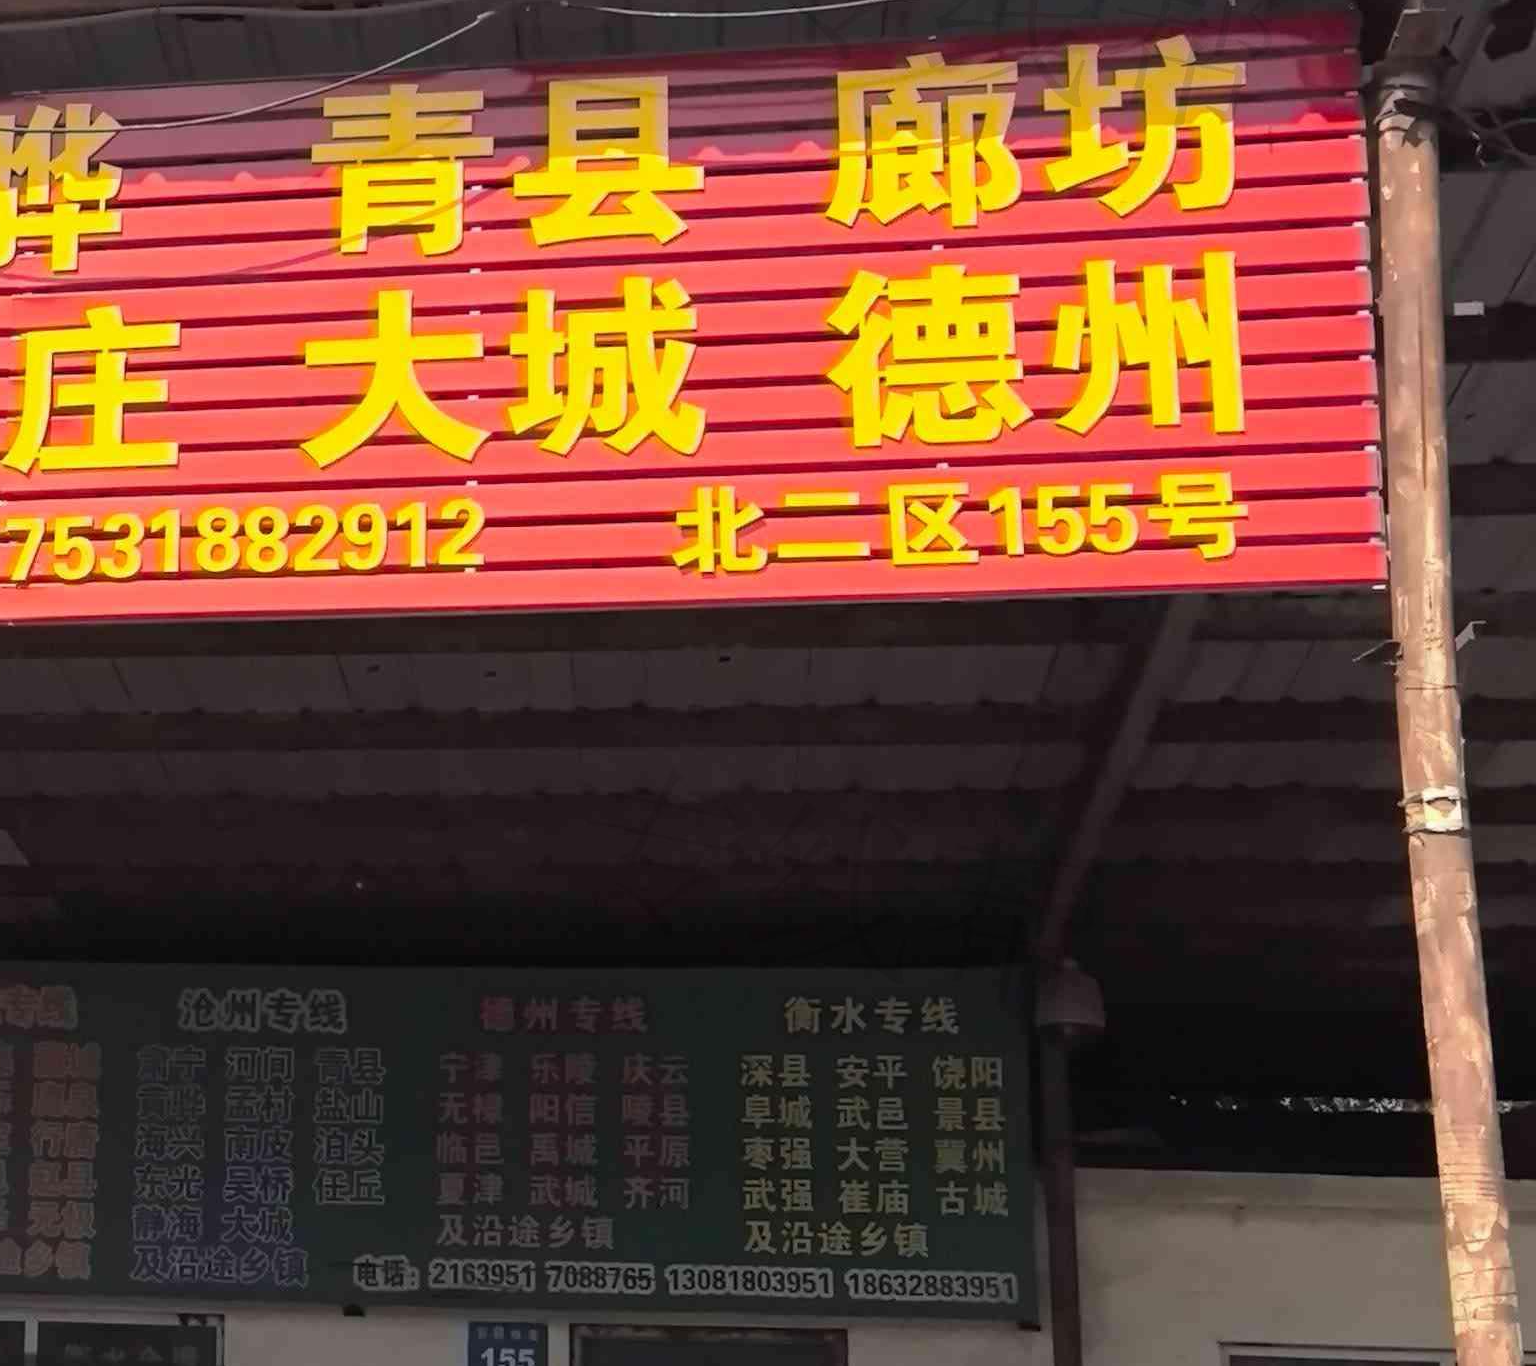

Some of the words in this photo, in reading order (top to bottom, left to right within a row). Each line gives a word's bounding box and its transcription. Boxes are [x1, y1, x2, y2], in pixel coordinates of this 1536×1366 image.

[311, 76, 704, 256] 青县
[821, 36, 1247, 228] 廊坊
[298, 274, 706, 469] 大城
[824, 250, 1245, 449] 德州
[670, 471, 1249, 574] 北二区155号
[178, 987, 347, 1033] 沧州专线
[479, 994, 648, 1034] 德州专线
[784, 996, 961, 1035] 衡水专线
[225, 1045, 295, 1083] 河间
[313, 1047, 387, 1085] 青县
[623, 1053, 689, 1085] 庆云
[741, 1055, 812, 1089] 深县
[836, 1055, 909, 1089] 安平
[931, 1056, 1005, 1090] 饶阳
[224, 1084, 296, 1123] 孟村
[313, 1086, 384, 1124] 盐山
[529, 1093, 599, 1126] 阳信
[741, 1095, 814, 1131] 阜城
[836, 1097, 910, 1132] 武邑
[934, 1097, 1007, 1132] 景县
[224, 1125, 295, 1163] 南皮
[313, 1127, 385, 1165] 泊头
[624, 1134, 691, 1169] 平原
[743, 1138, 814, 1173] 枣强
[836, 1139, 910, 1173] 大营
[934, 1139, 1007, 1174] 冀州
[134, 1163, 204, 1202] 东光
[224, 1165, 295, 1204] 吴桥
[313, 1166, 385, 1205] 任丘
[624, 1175, 691, 1211] 齐河
[743, 1179, 814, 1214] 武强
[838, 1179, 911, 1215] 崔庙
[936, 1180, 1010, 1216] 古城
[436, 1214, 615, 1251] 及沿途乡镇
[744, 1221, 930, 1259] 及沿途乡镇
[129, 1246, 310, 1291] 及沿途乡镇
[431, 1262, 534, 1290] 2163951
[548, 1264, 654, 1293] 7088765
[668, 1267, 832, 1298] 13081803951
[848, 1271, 1017, 1302] 18632883951
